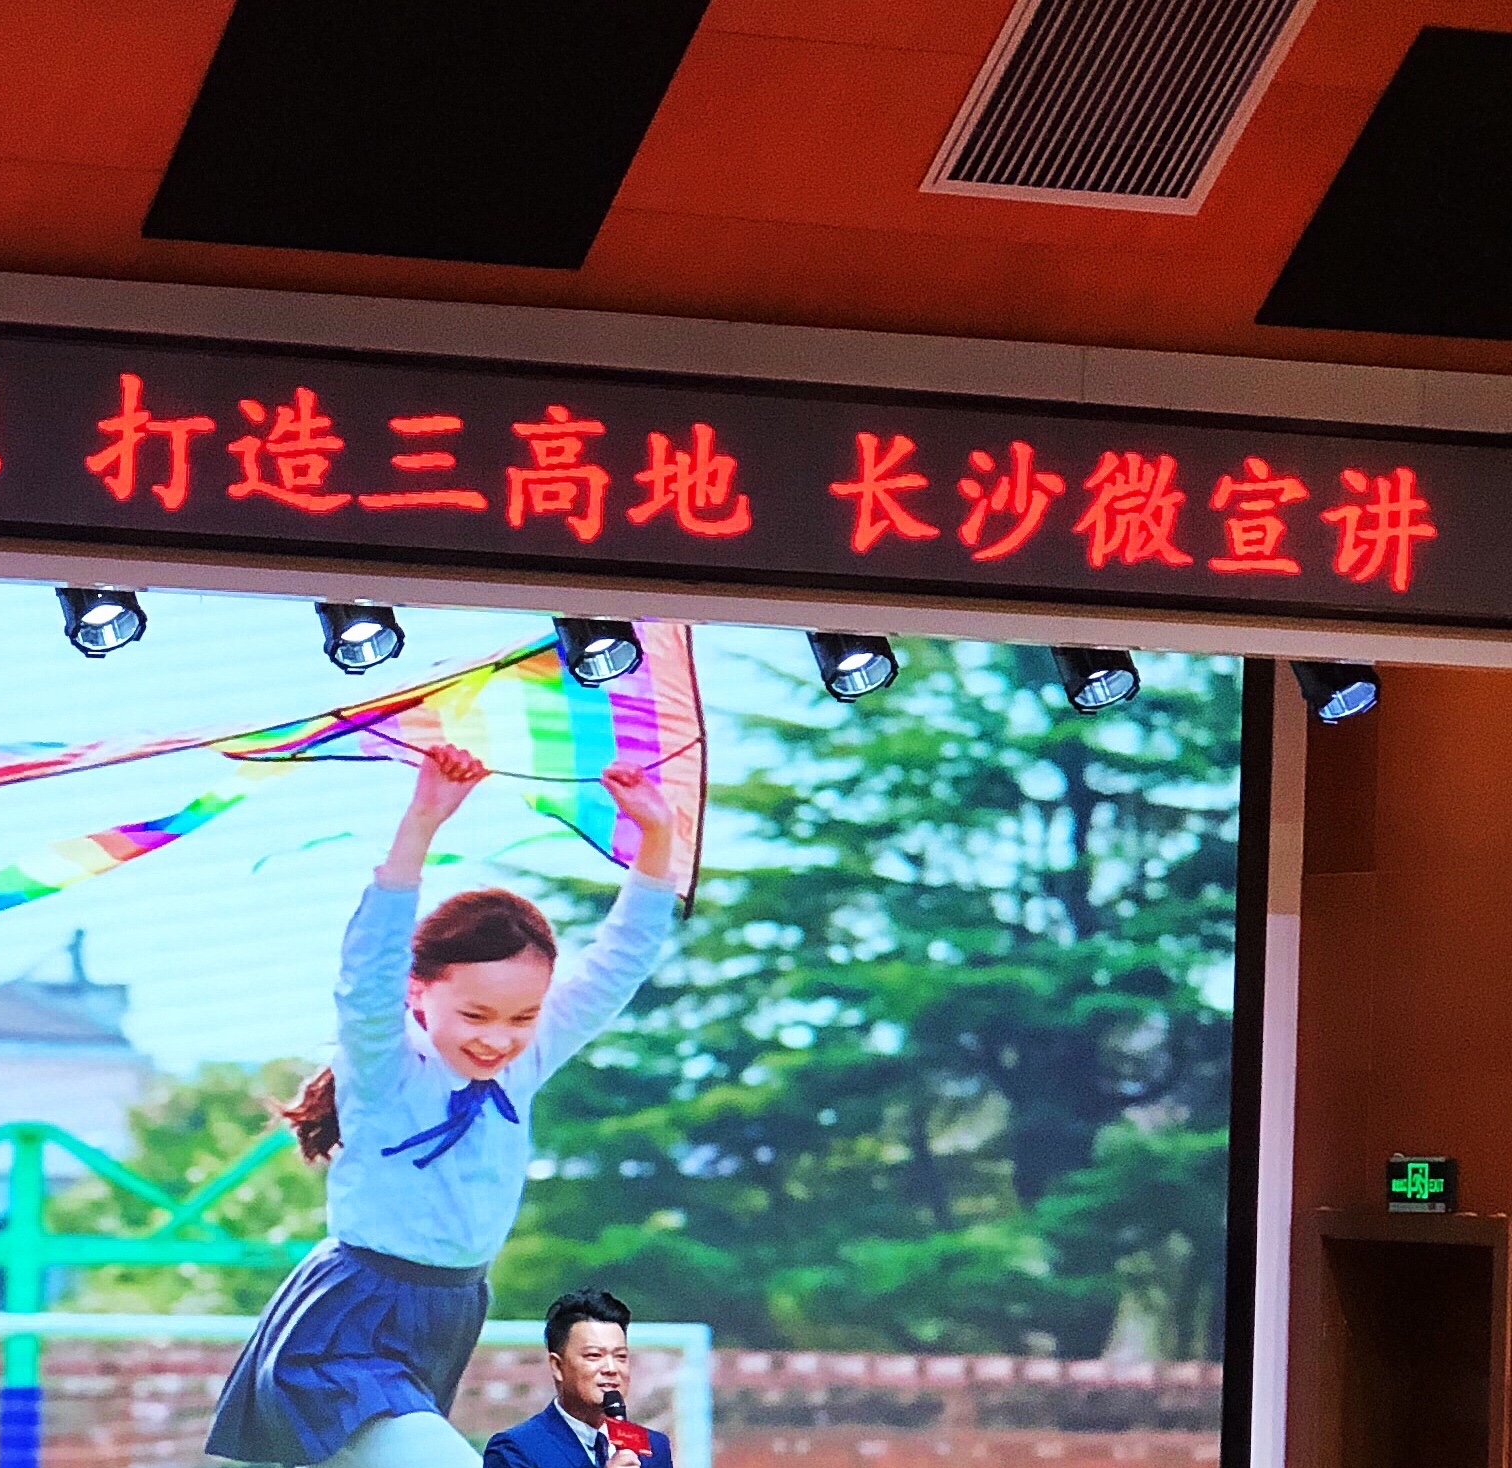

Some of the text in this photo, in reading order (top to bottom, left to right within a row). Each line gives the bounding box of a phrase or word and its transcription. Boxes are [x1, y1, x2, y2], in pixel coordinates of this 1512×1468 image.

[85, 373, 752, 542] 打造三高地
[829, 432, 1437, 592] 长沙微宣讲
